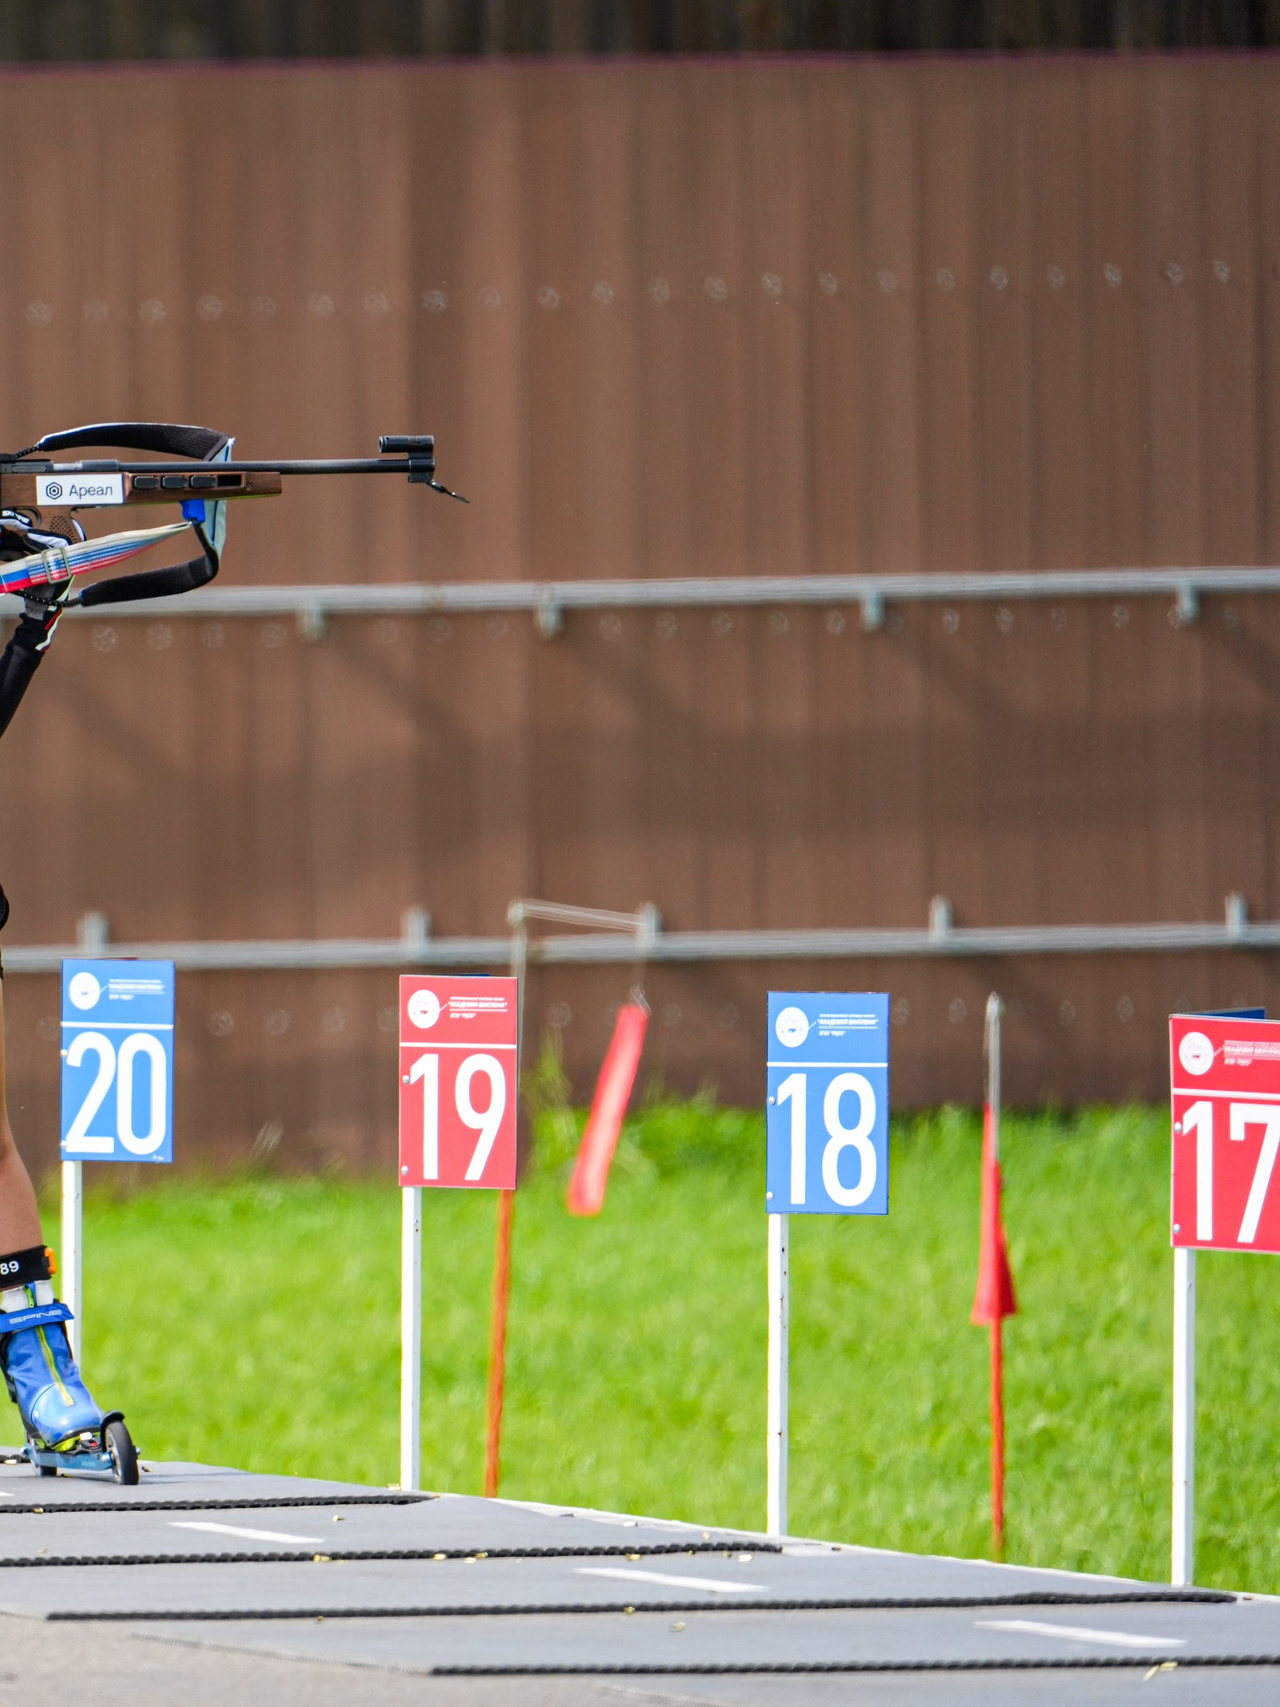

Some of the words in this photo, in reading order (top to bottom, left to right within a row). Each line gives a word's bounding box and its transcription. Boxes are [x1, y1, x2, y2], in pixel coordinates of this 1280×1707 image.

[69, 485, 113, 499] Ареал
[66, 1032, 167, 1155] 20
[410, 1053, 506, 1181] 19
[777, 1072, 877, 1207] 18
[1182, 1101, 1280, 1243] 17
[9, 1309, 62, 1324] SPINE
